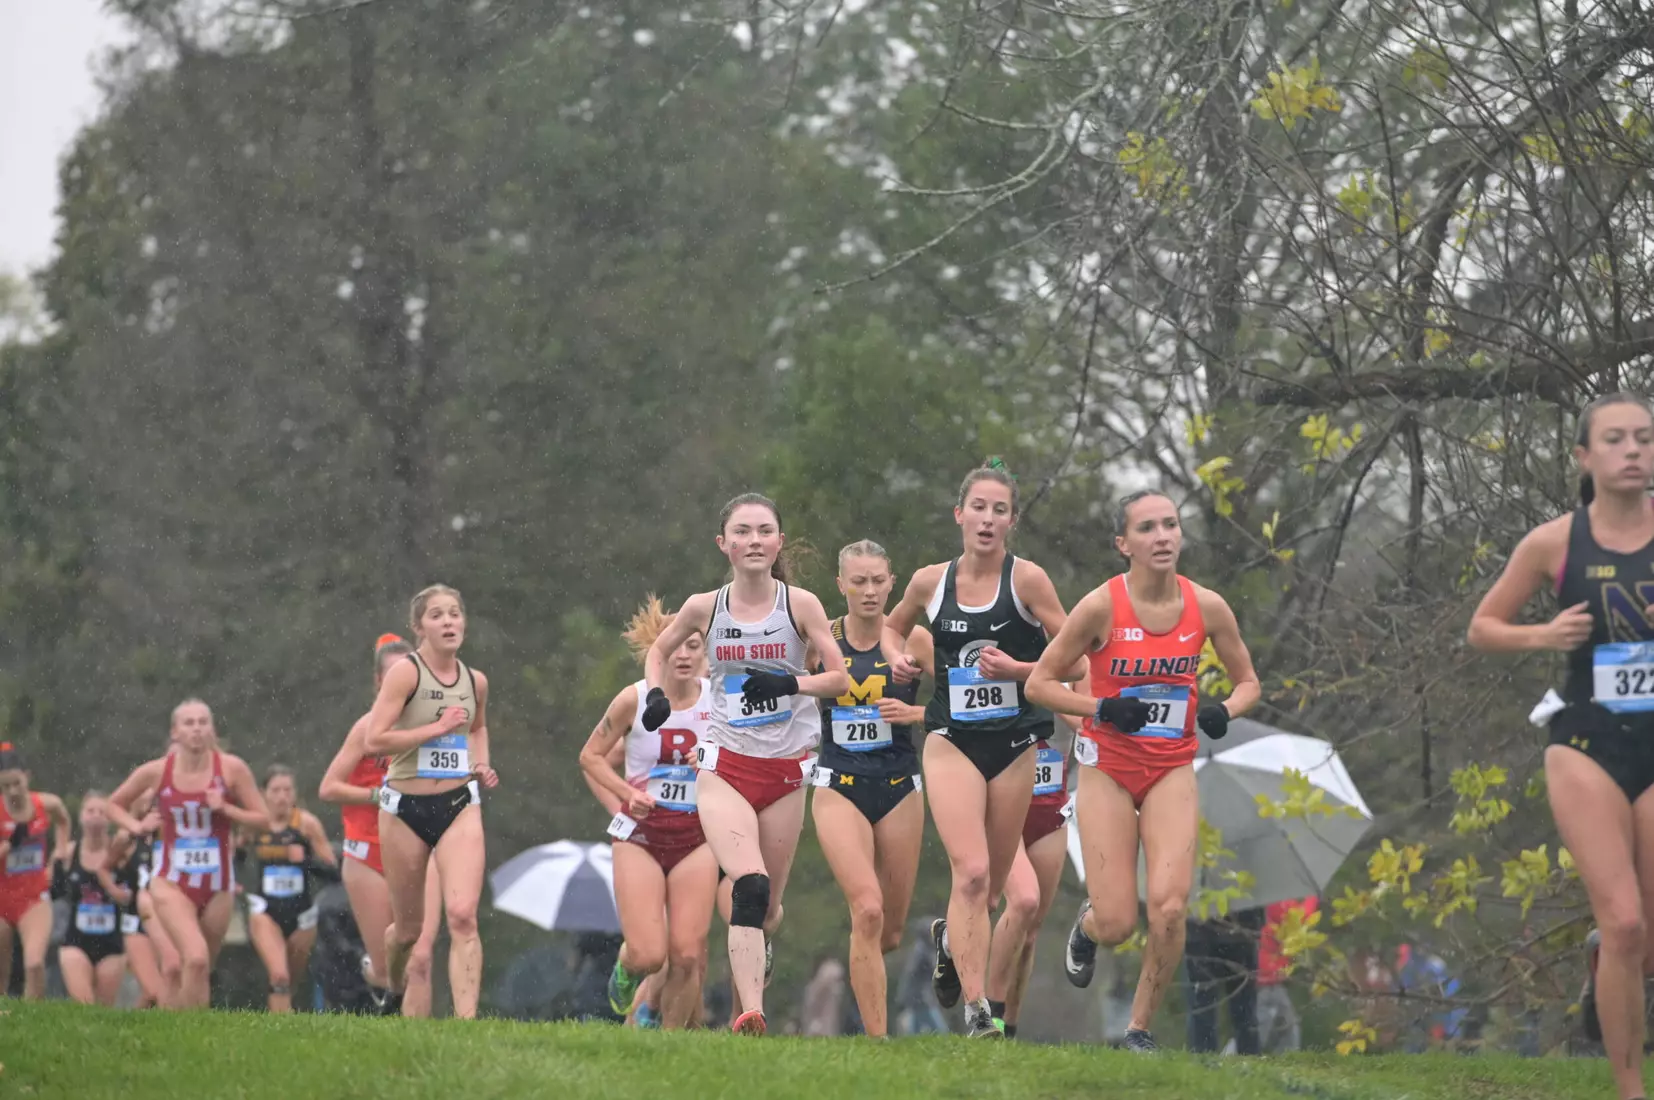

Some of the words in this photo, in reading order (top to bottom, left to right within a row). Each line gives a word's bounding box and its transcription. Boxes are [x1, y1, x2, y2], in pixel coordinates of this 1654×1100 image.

[716, 645, 745, 661] OHIO
[750, 643, 787, 660] STATE
[836, 674, 887, 706] M
[964, 686, 1003, 709] 298
[1146, 702, 1171, 724] 37
[846, 722, 878, 741] 278
[658, 728, 698, 764] R
[430, 751, 459, 769] 359
[840, 774, 854, 786] M
[661, 782, 687, 801] 371
[184, 851, 210, 864] 244
